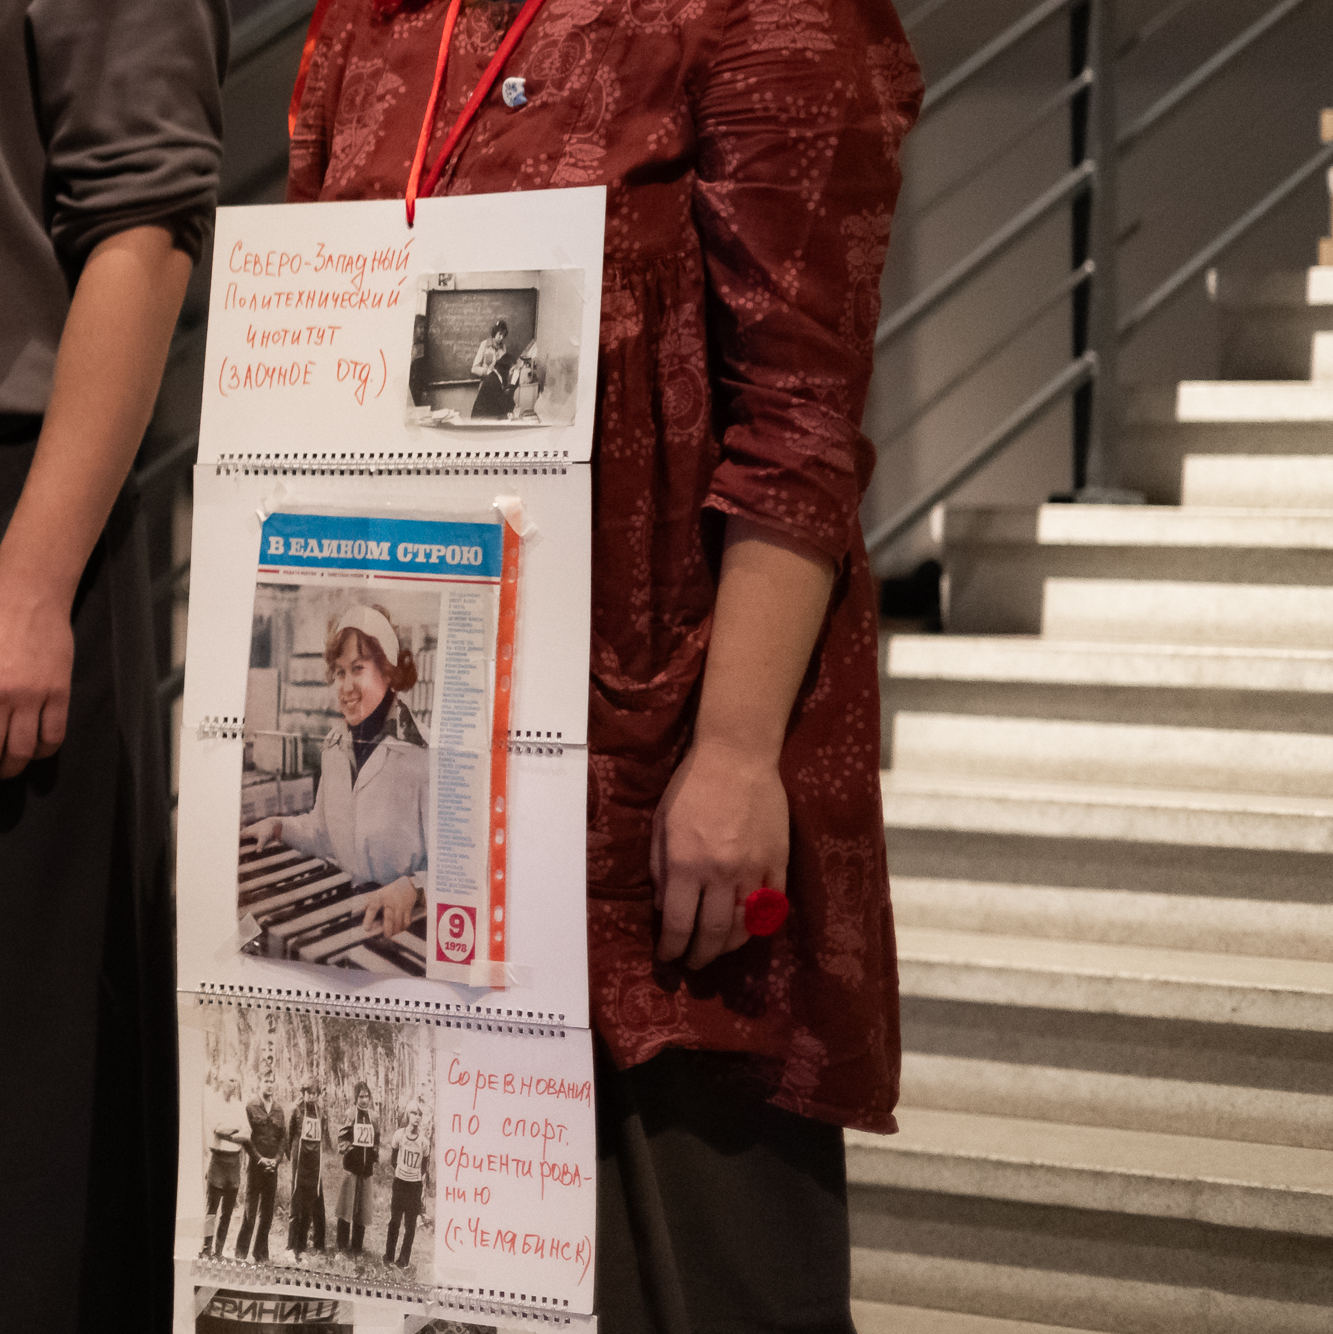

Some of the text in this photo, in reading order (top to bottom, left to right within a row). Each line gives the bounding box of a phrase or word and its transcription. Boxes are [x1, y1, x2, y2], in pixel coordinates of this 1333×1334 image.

[268, 536, 484, 565] В ЕДИНОМ СТРОЮ
[449, 913, 465, 939] 9
[444, 941, 468, 953] 1978
[357, 1126, 373, 1144] 221
[403, 1148, 421, 1168] 107
